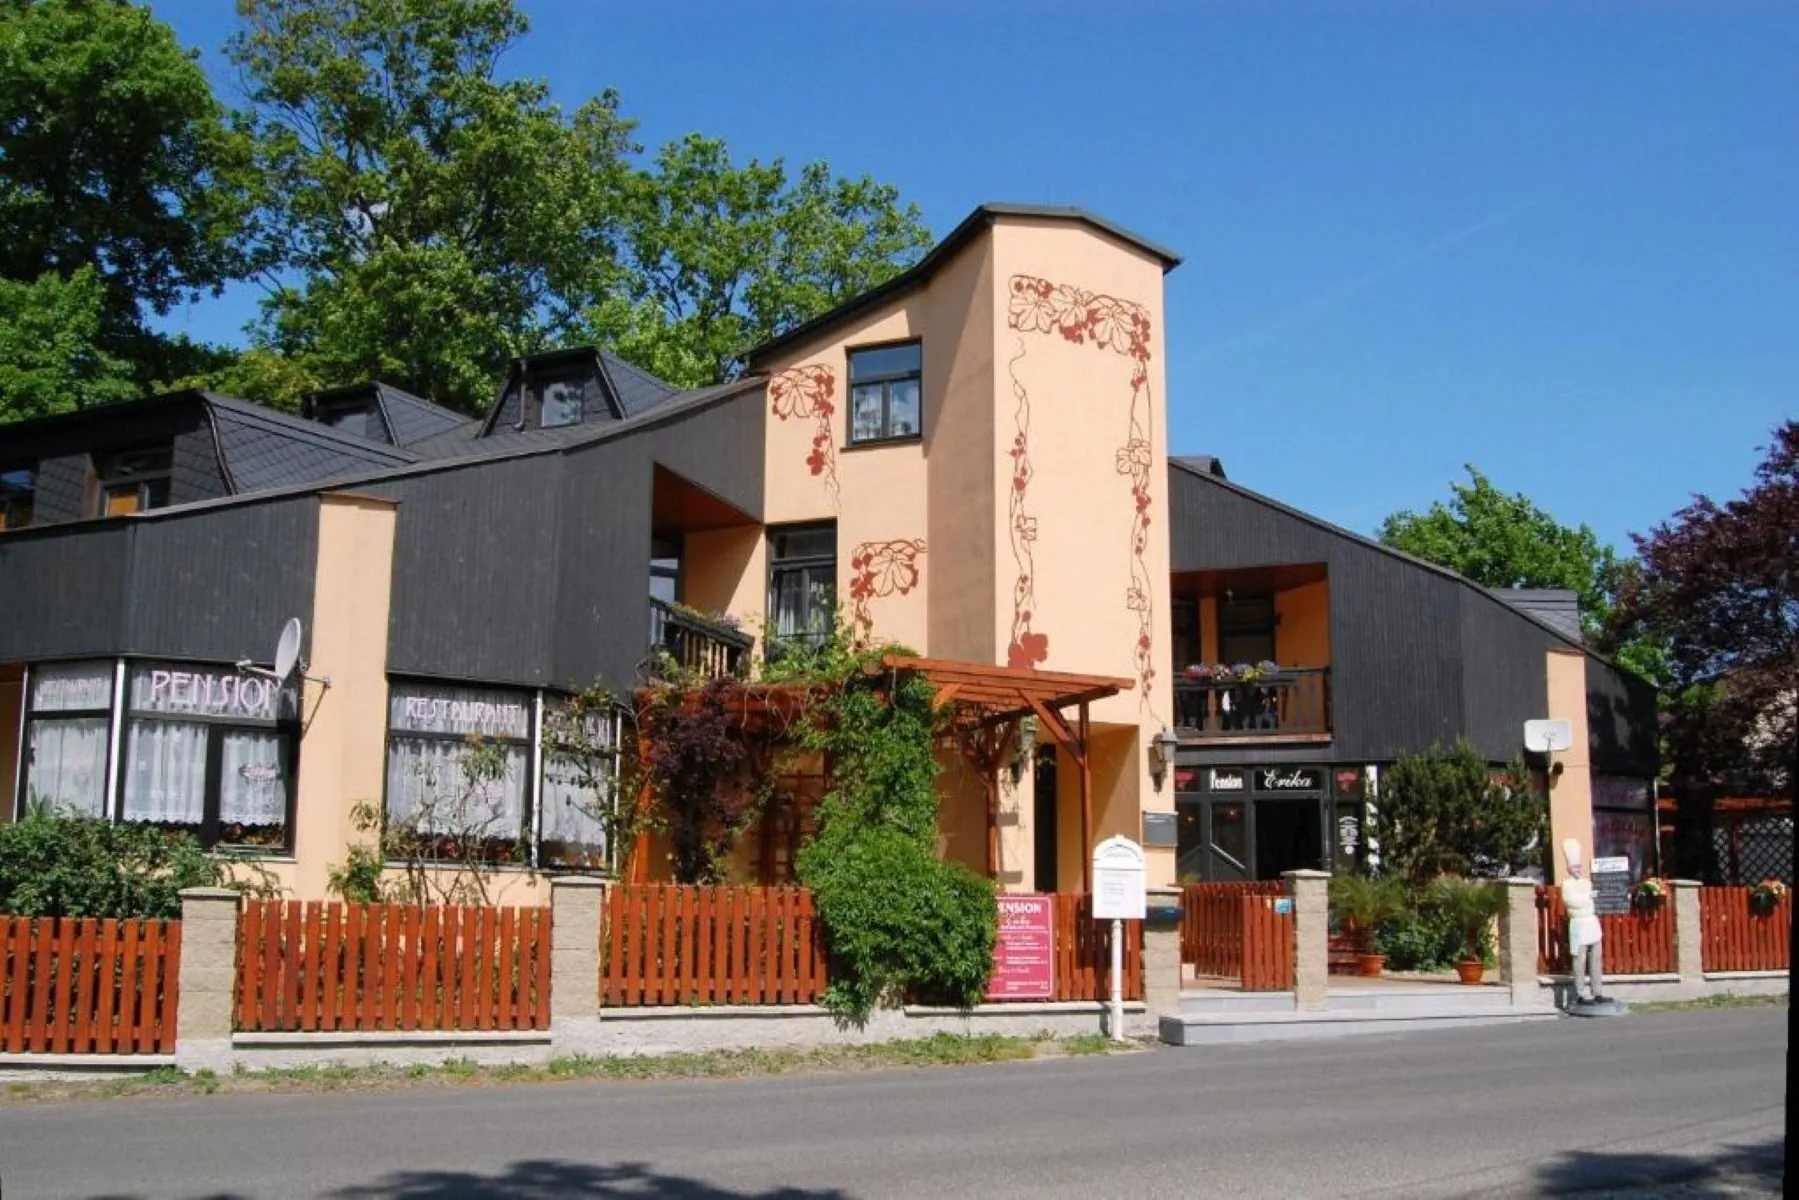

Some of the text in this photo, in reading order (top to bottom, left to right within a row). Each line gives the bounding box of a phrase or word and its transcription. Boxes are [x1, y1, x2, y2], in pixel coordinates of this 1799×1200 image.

[406, 696, 519, 723] RESTAURANT
[1209, 768, 1243, 789] Pension
[1263, 768, 1312, 790] Erika
[997, 902, 1042, 914] ENSION
